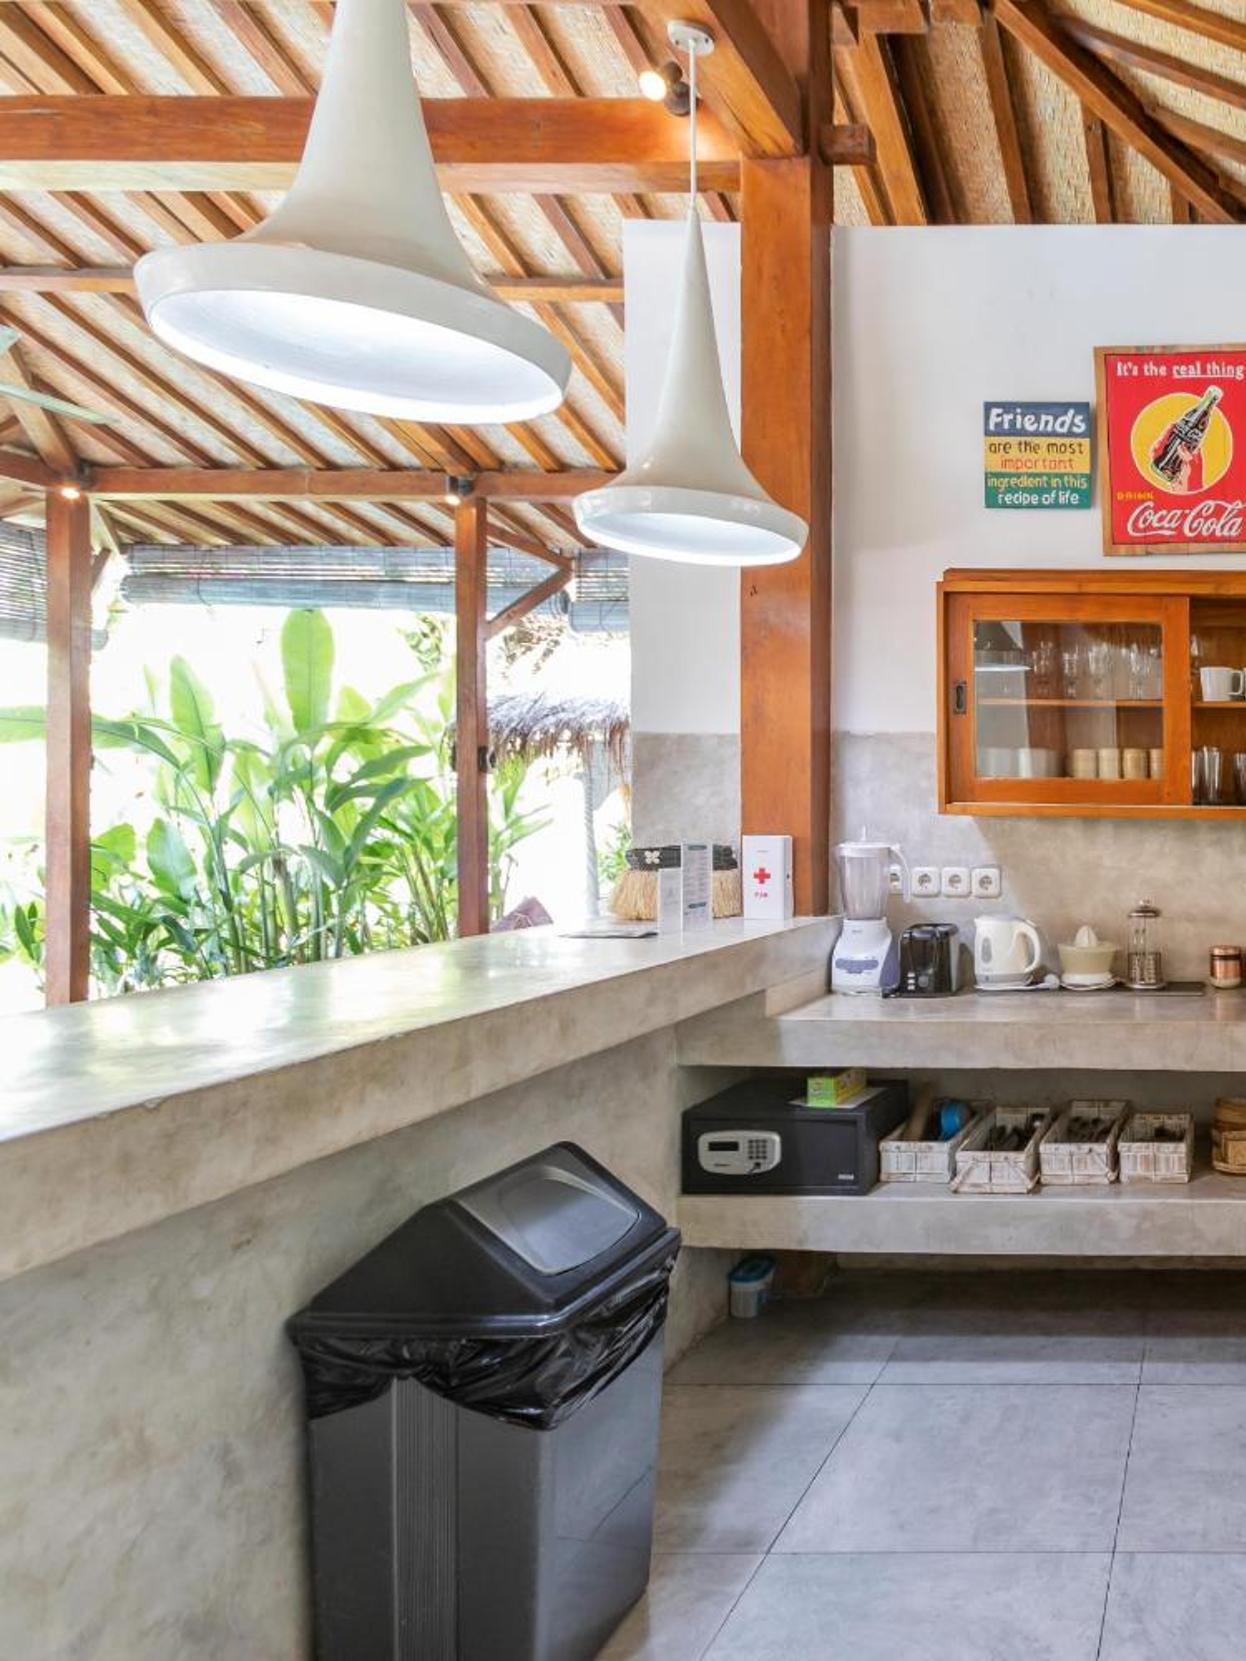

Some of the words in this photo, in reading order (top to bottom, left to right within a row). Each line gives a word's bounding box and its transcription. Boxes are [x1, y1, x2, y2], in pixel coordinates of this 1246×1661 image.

[1117, 361, 1138, 376] It's
[1143, 361, 1167, 377] the
[1173, 361, 1201, 379] real
[1206, 361, 1245, 380] thing
[988, 407, 1087, 433] Friends
[988, 441, 1012, 454] are
[1018, 440, 1040, 454] the
[1047, 441, 1084, 455] most
[1001, 457, 1074, 470] important
[987, 475, 1048, 492] ingredient
[1051, 475, 1062, 488] in
[1064, 475, 1087, 489] this
[998, 490, 1039, 506] recipe
[1042, 489, 1057, 505] of
[1058, 490, 1079, 505] life
